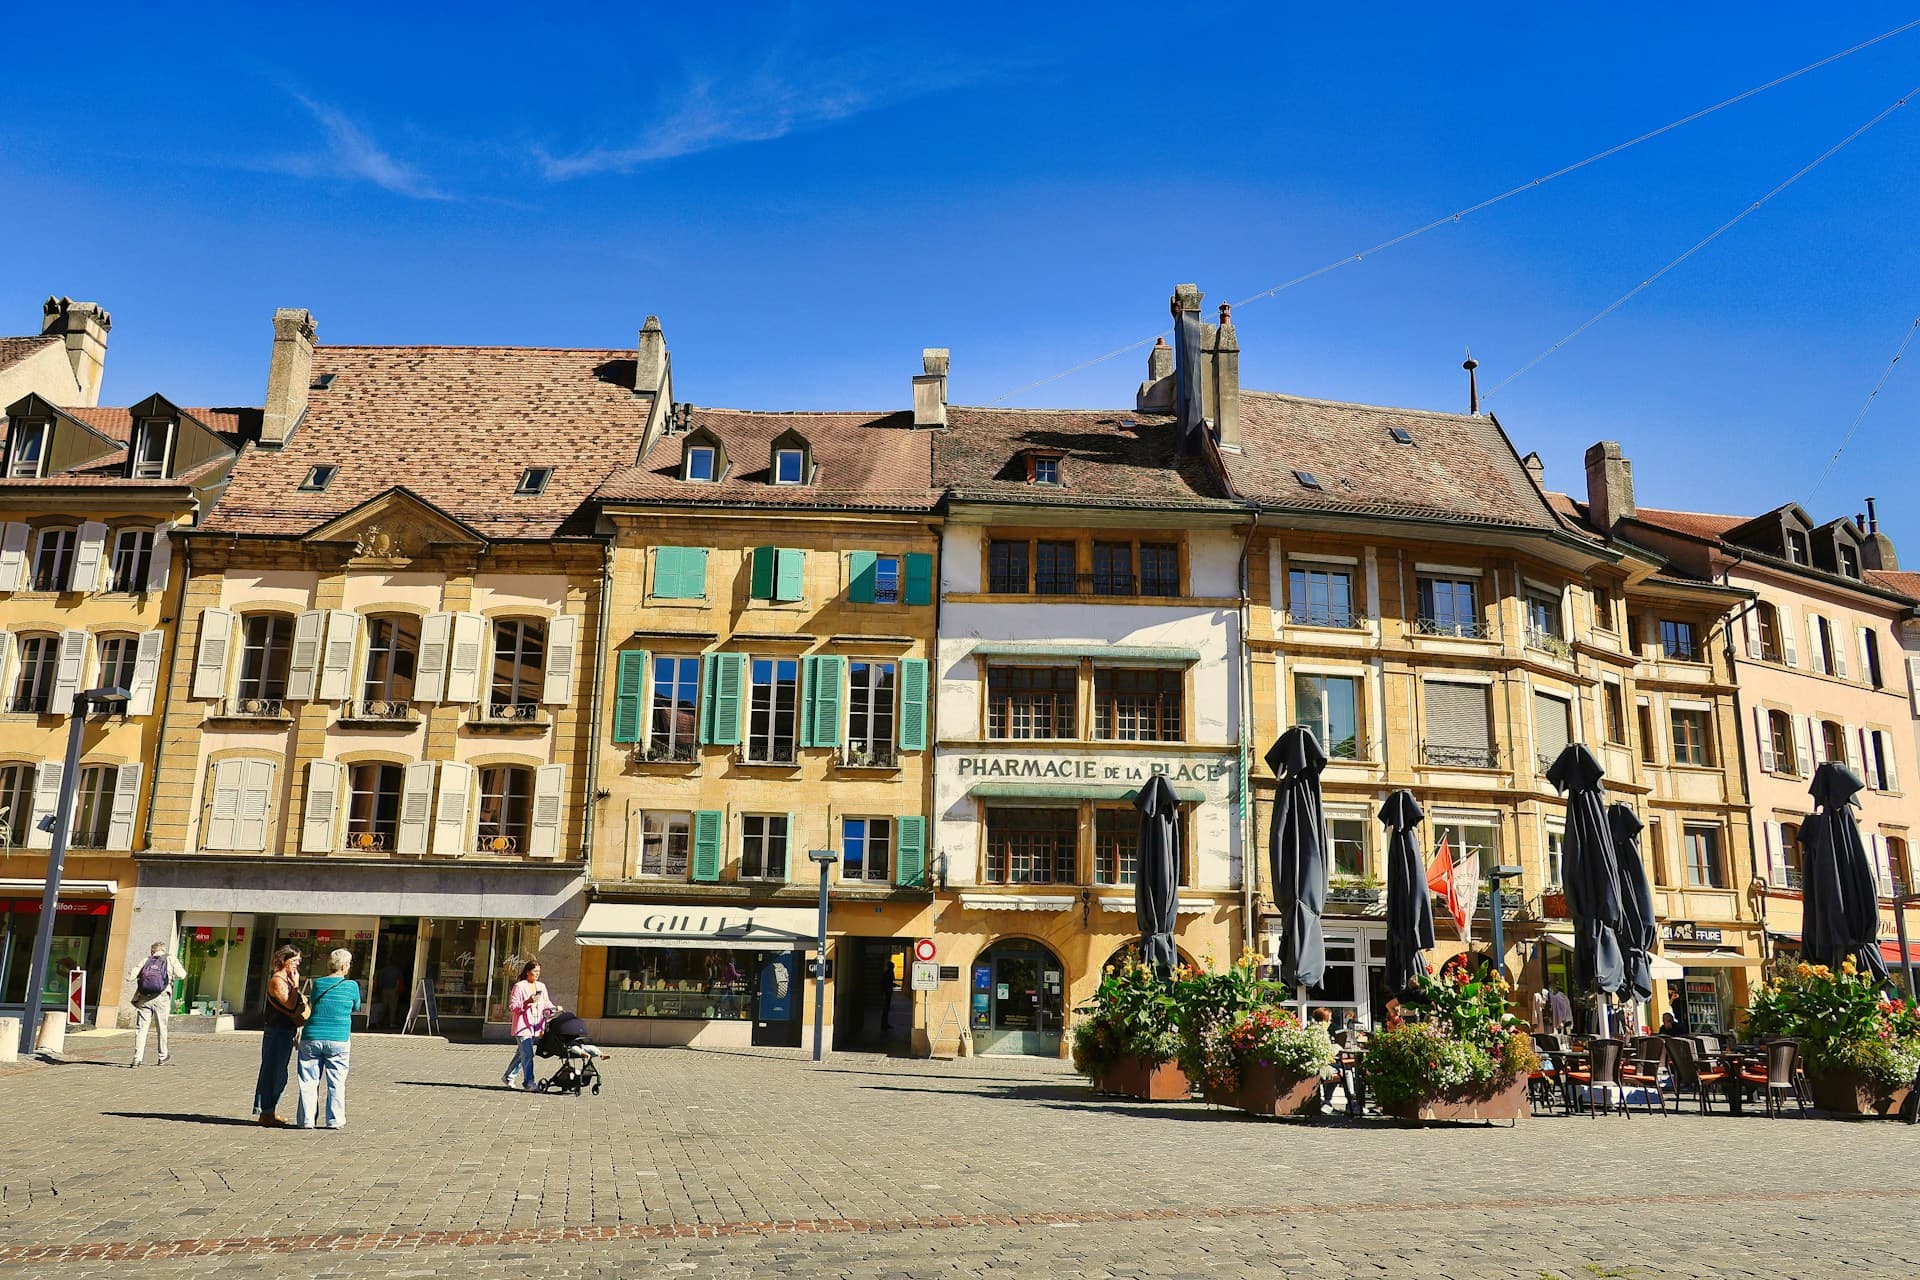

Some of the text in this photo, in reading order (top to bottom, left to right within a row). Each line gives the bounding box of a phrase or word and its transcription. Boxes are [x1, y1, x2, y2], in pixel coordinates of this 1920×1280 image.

[957, 758, 1097, 778] PHARMACIE
[1104, 767, 1120, 779] DE
[1126, 767, 1142, 780] LA
[288, 929, 306, 938] elna
[354, 930, 372, 939] elna
[1696, 930, 1721, 941] FFURE
